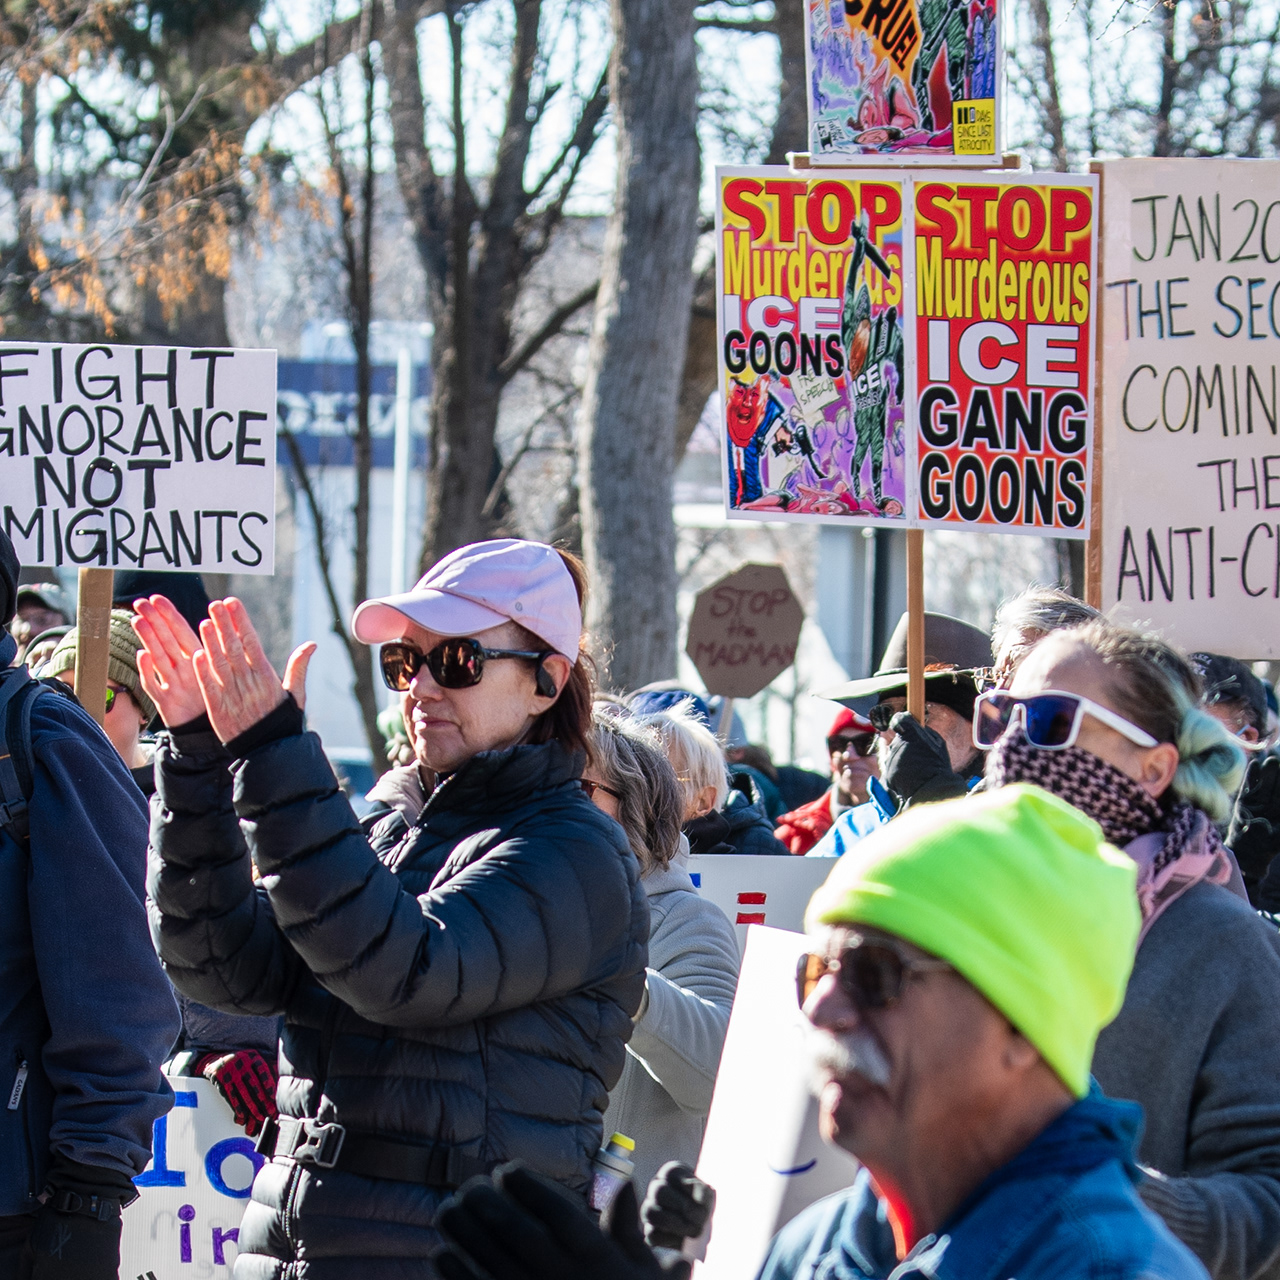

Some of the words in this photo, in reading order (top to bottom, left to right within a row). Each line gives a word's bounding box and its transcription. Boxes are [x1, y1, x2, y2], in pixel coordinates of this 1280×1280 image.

[723, 178, 902, 246] STOP
[915, 183, 1093, 252] STOP
[915, 236, 1091, 325] Murderous
[1106, 276, 1196, 340] THE
[724, 294, 841, 338] ICE
[724, 330, 844, 378] GOONS
[852, 363, 881, 396] ICE
[928, 319, 1080, 388] ICE
[920, 386, 1087, 455] GANG
[34, 456, 171, 509] NOT
[920, 453, 1086, 528] GOONS
[709, 585, 791, 617] STOP
